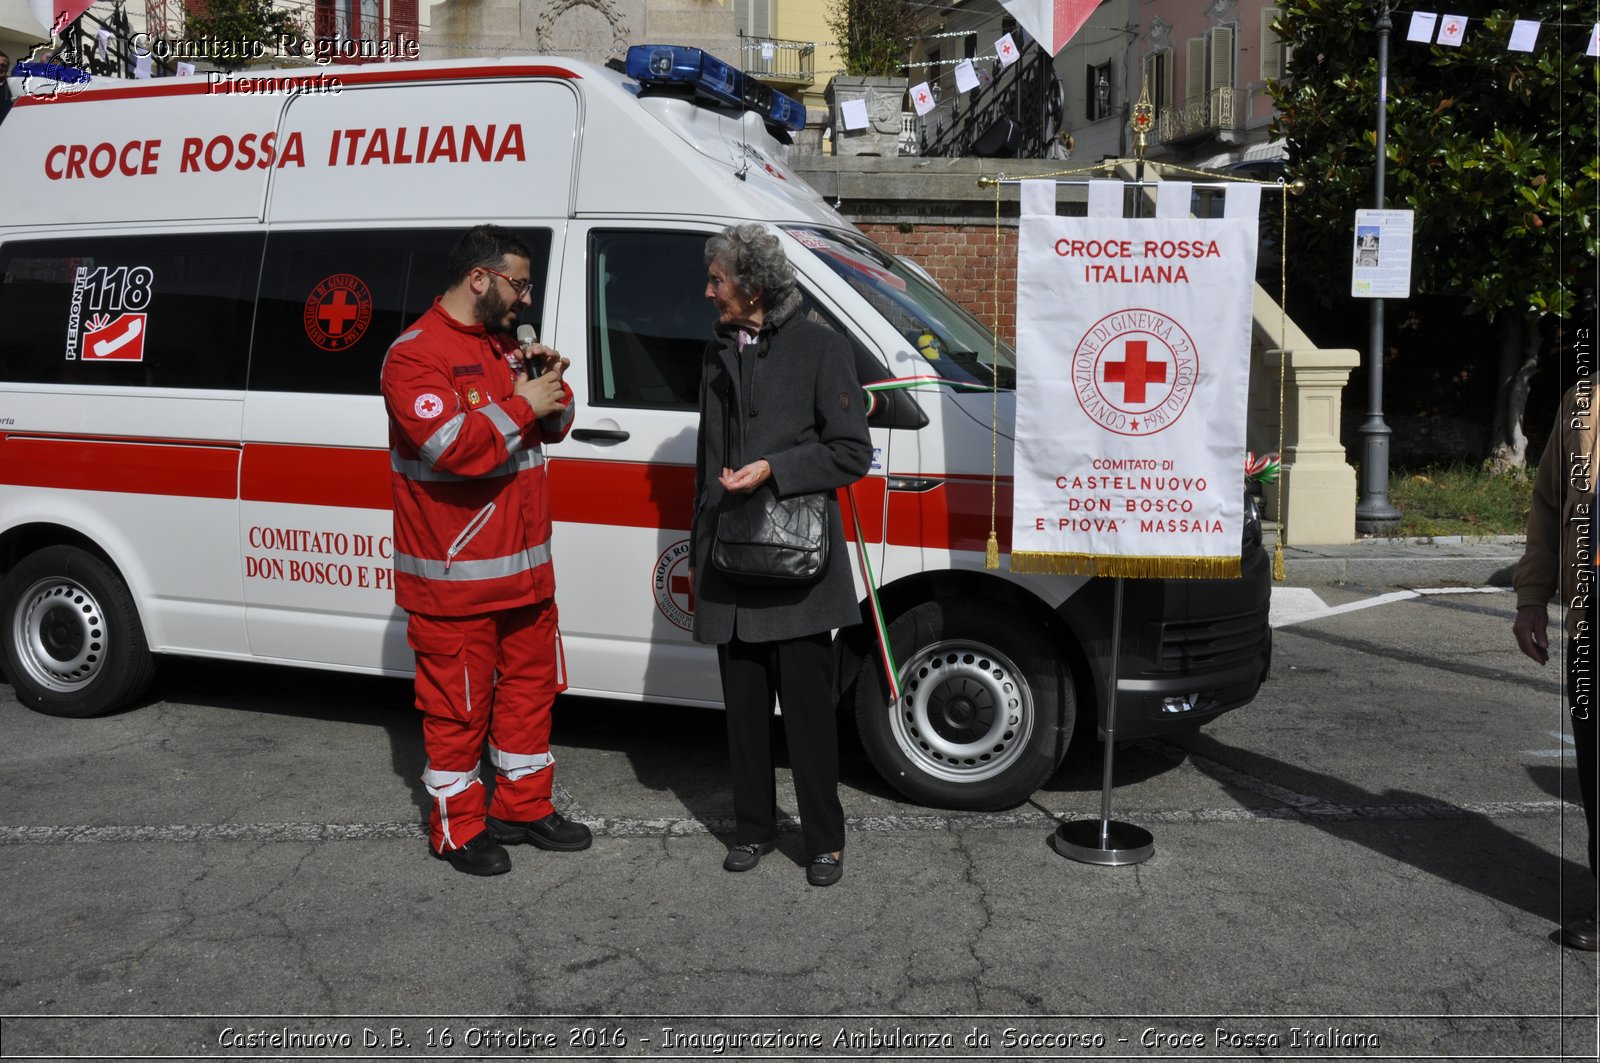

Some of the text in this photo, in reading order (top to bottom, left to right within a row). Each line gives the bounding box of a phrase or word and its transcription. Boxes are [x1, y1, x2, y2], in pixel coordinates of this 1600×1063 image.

[45, 124, 526, 180] CROCE ROSSA ITALIANA
[1055, 238, 1221, 259] CROCE ROSSA
[1085, 265, 1189, 283] ITALIANA
[84, 266, 154, 310] 118
[66, 267, 87, 360] PIEMONTE
[1076, 313, 1193, 430] CONVENZIONE DI GINEVRA 22 AGOSTO 1864
[0, 417, 15, 425] rta
[1093, 459, 1174, 470] COMITATO DI
[1056, 476, 1207, 491] CASTELNUOVO
[1069, 498, 1193, 512] DON BOSCO
[1036, 518, 1045, 530] E
[1140, 520, 1223, 533] MASSAIA
[249, 526, 394, 559] COMITATO DI C
[245, 556, 394, 590] DON BOSCO E PI
[656, 544, 689, 590] CROCE RO
